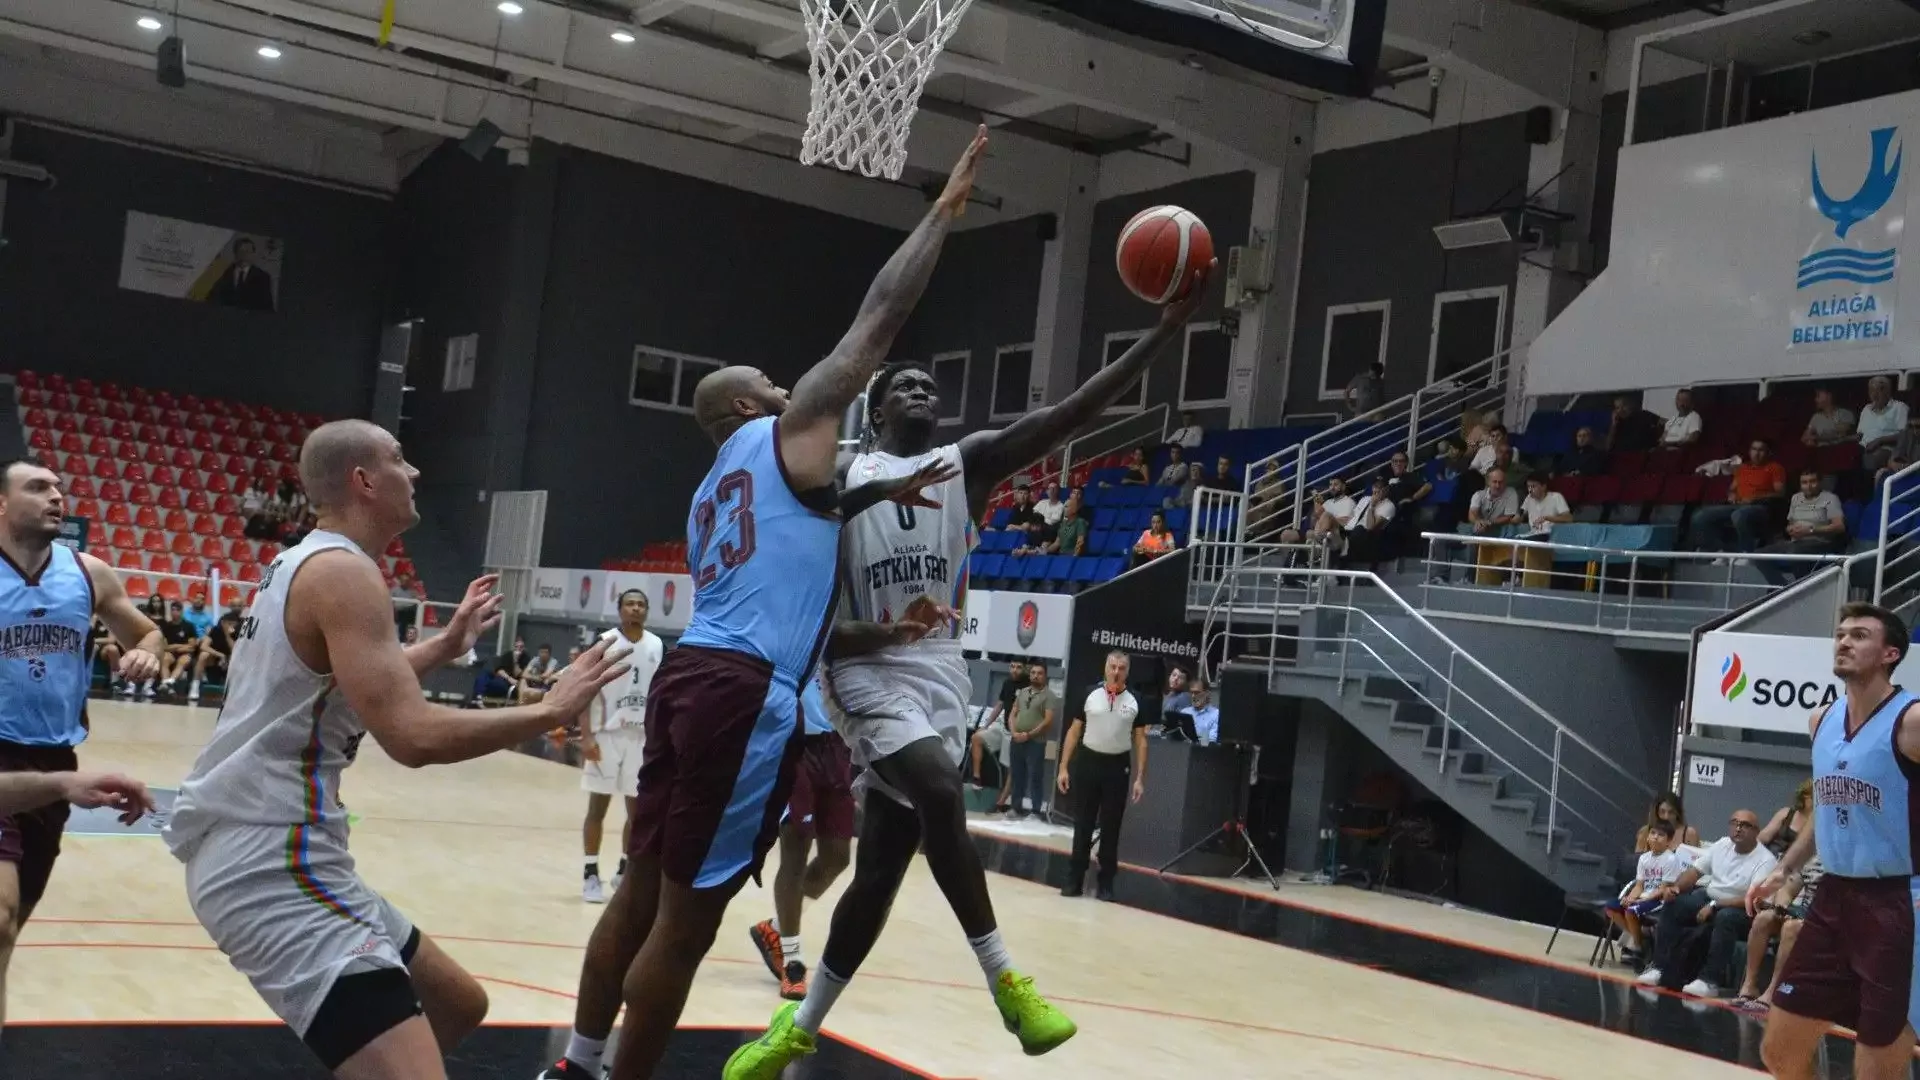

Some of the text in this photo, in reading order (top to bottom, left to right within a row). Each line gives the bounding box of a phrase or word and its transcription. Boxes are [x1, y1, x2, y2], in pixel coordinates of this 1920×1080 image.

[1808, 292, 1876, 317] ALİAĞA
[1792, 314, 1889, 344] BELEDİYESİ
[694, 468, 756, 590] 23
[0, 624, 81, 653] ABZONSPOR
[1091, 629, 1200, 657] #BirlikteHedefe
[632, 666, 640, 685] 3
[1752, 678, 1847, 710] SOCA
[1696, 763, 1720, 777] VIP
